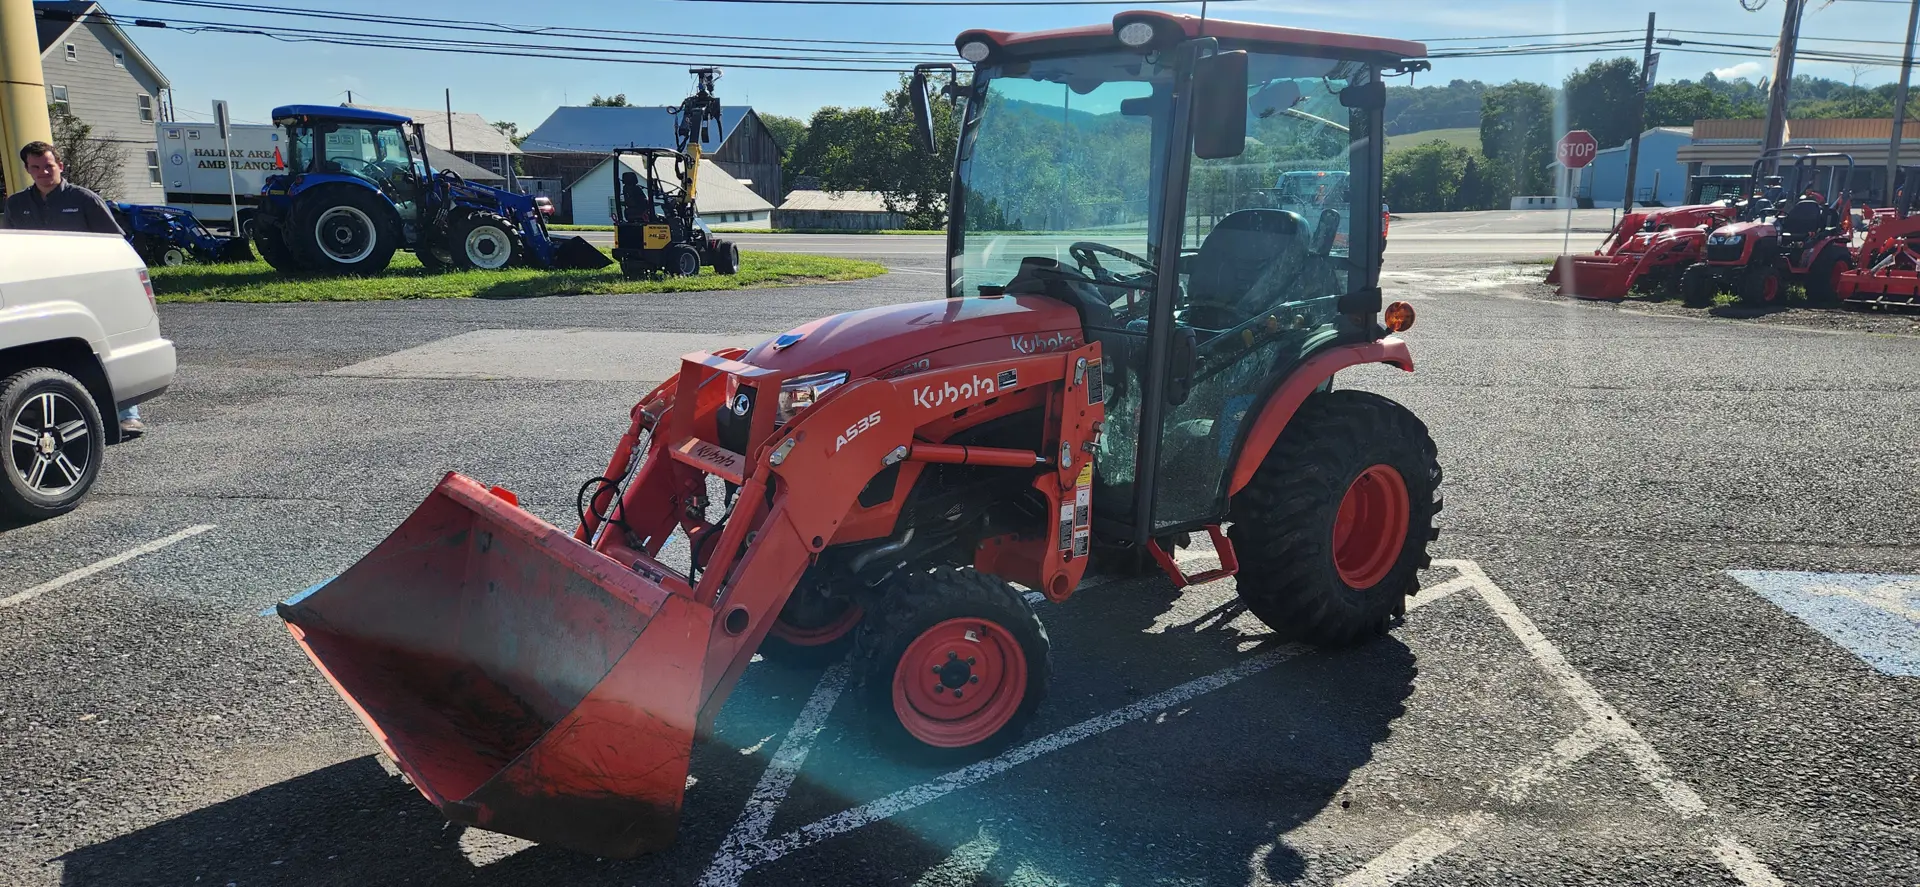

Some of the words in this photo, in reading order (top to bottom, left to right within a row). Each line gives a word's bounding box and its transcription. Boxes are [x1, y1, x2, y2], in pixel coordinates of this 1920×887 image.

[247, 150, 276, 159] AREA
[1559, 143, 1594, 157] STOP
[1010, 332, 1075, 354] Kubota
[913, 374, 995, 409] Kubota
[696, 445, 736, 467] Kubota
